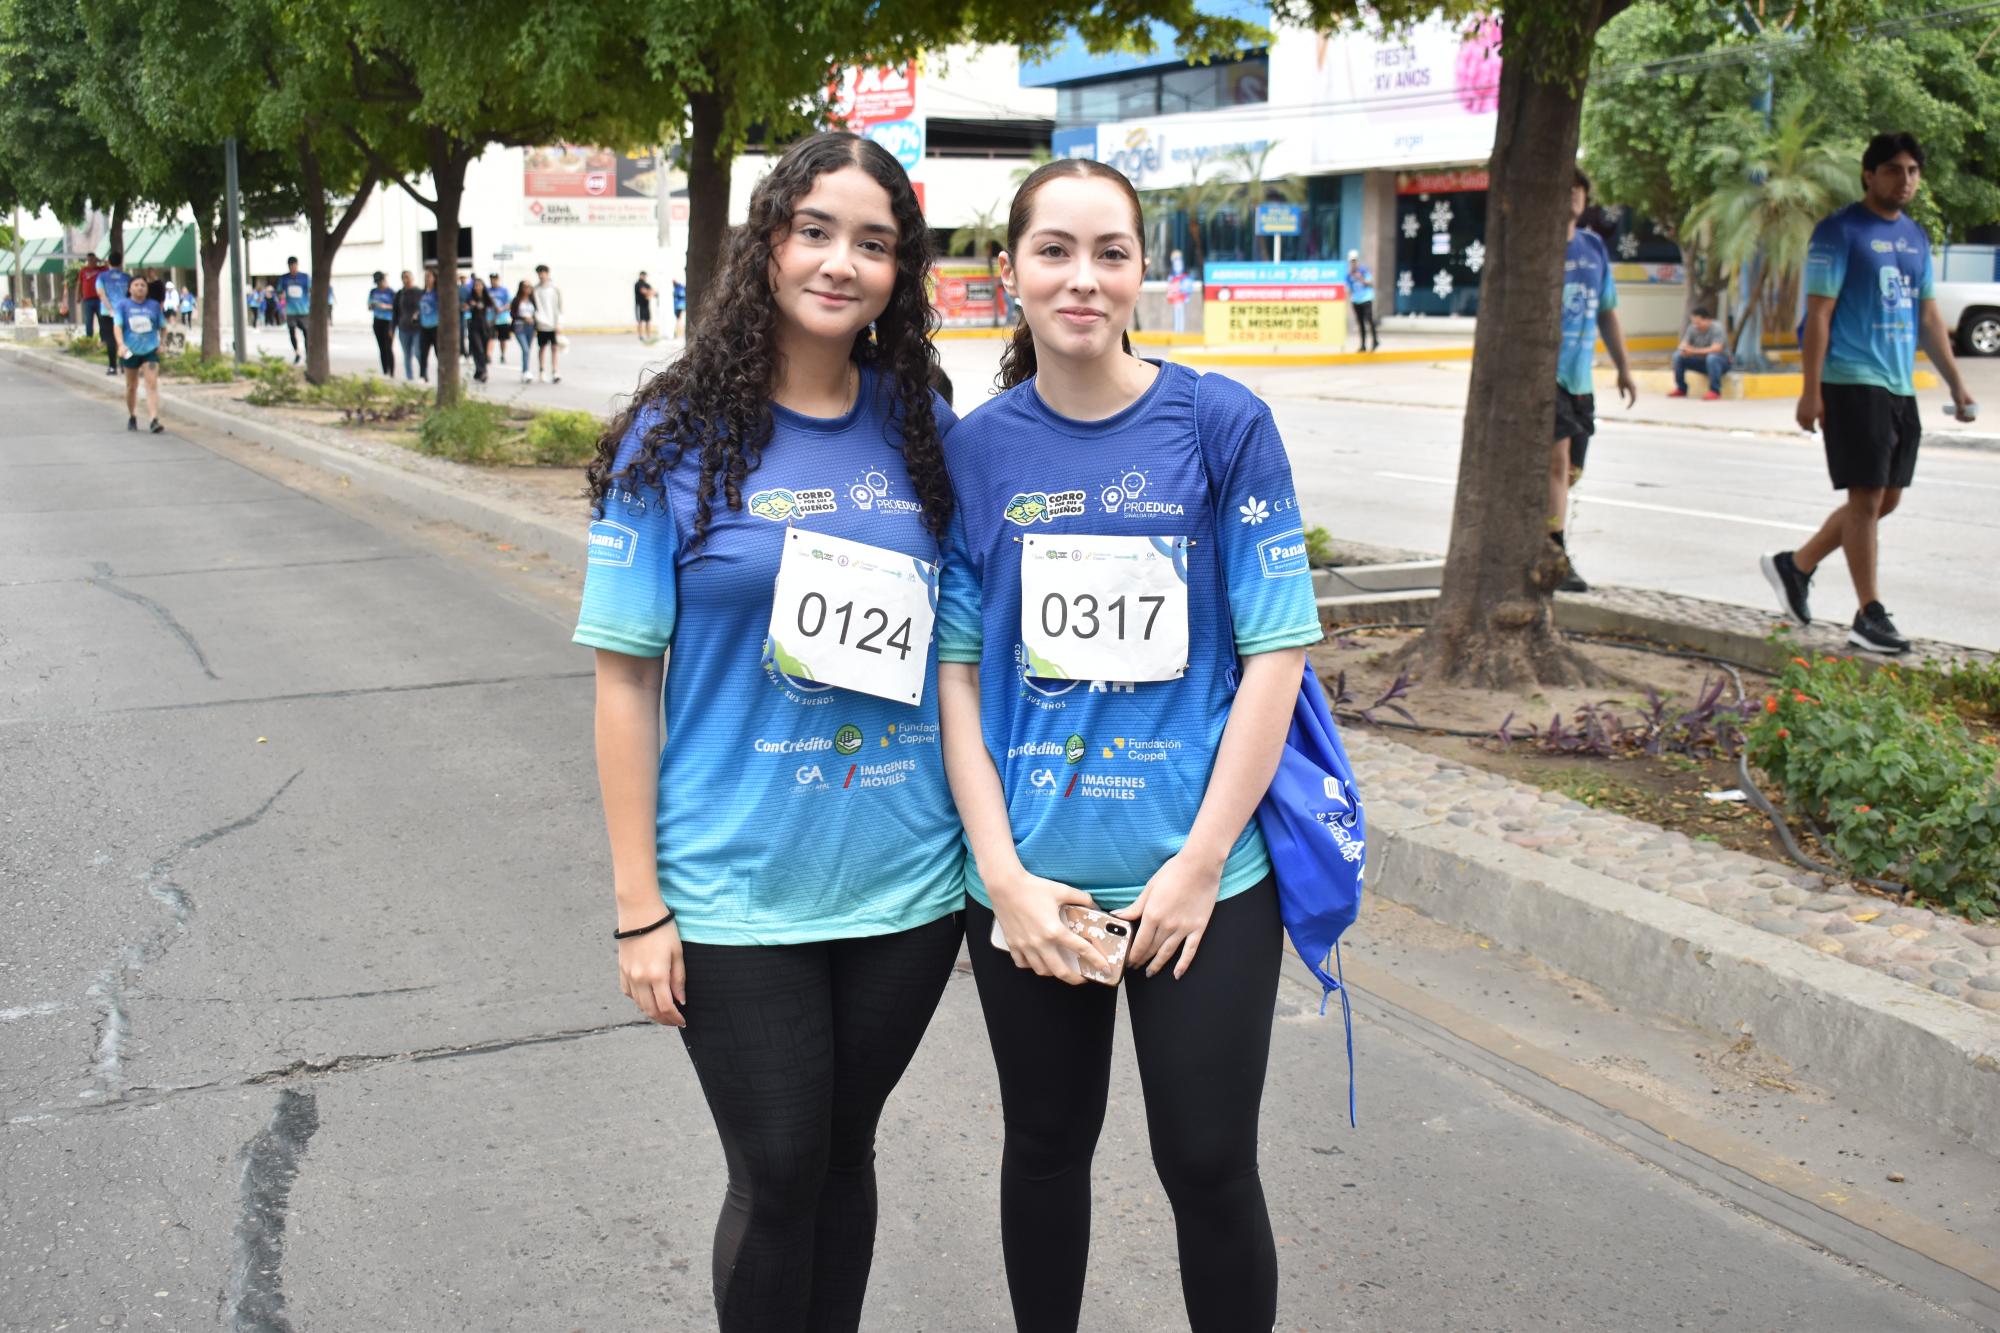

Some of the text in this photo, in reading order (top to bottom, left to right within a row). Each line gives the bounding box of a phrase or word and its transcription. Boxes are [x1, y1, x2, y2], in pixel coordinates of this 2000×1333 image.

[541, 213, 579, 224] Express
[1212, 269, 1256, 280] ABRIMOS
[1268, 269, 1287, 280] LAS
[1290, 268, 1318, 280] 7:00
[1234, 288, 1283, 299] SERVICIOS
[1230, 306, 1319, 316] ENTREGAMOS
[1230, 319, 1242, 329] EL
[1248, 319, 1293, 329] MISMO
[1277, 332, 1319, 342] HORAS
[796, 491, 832, 500] CORRO
[1049, 493, 1083, 503] CORRO
[1049, 505, 1082, 515] SUEÑOS
[1124, 501, 1184, 516] PROEDUCA
[1041, 592, 1165, 641] 0317
[797, 591, 911, 660] 0124
[754, 736, 833, 754] ConCrédito
[898, 734, 936, 745] Coppel
[1128, 738, 1181, 749] Fundación
[1128, 750, 1167, 763] Coppel
[795, 759, 916, 785] GA IMAGENES
[1030, 768, 1146, 789] GA IMAGENES
